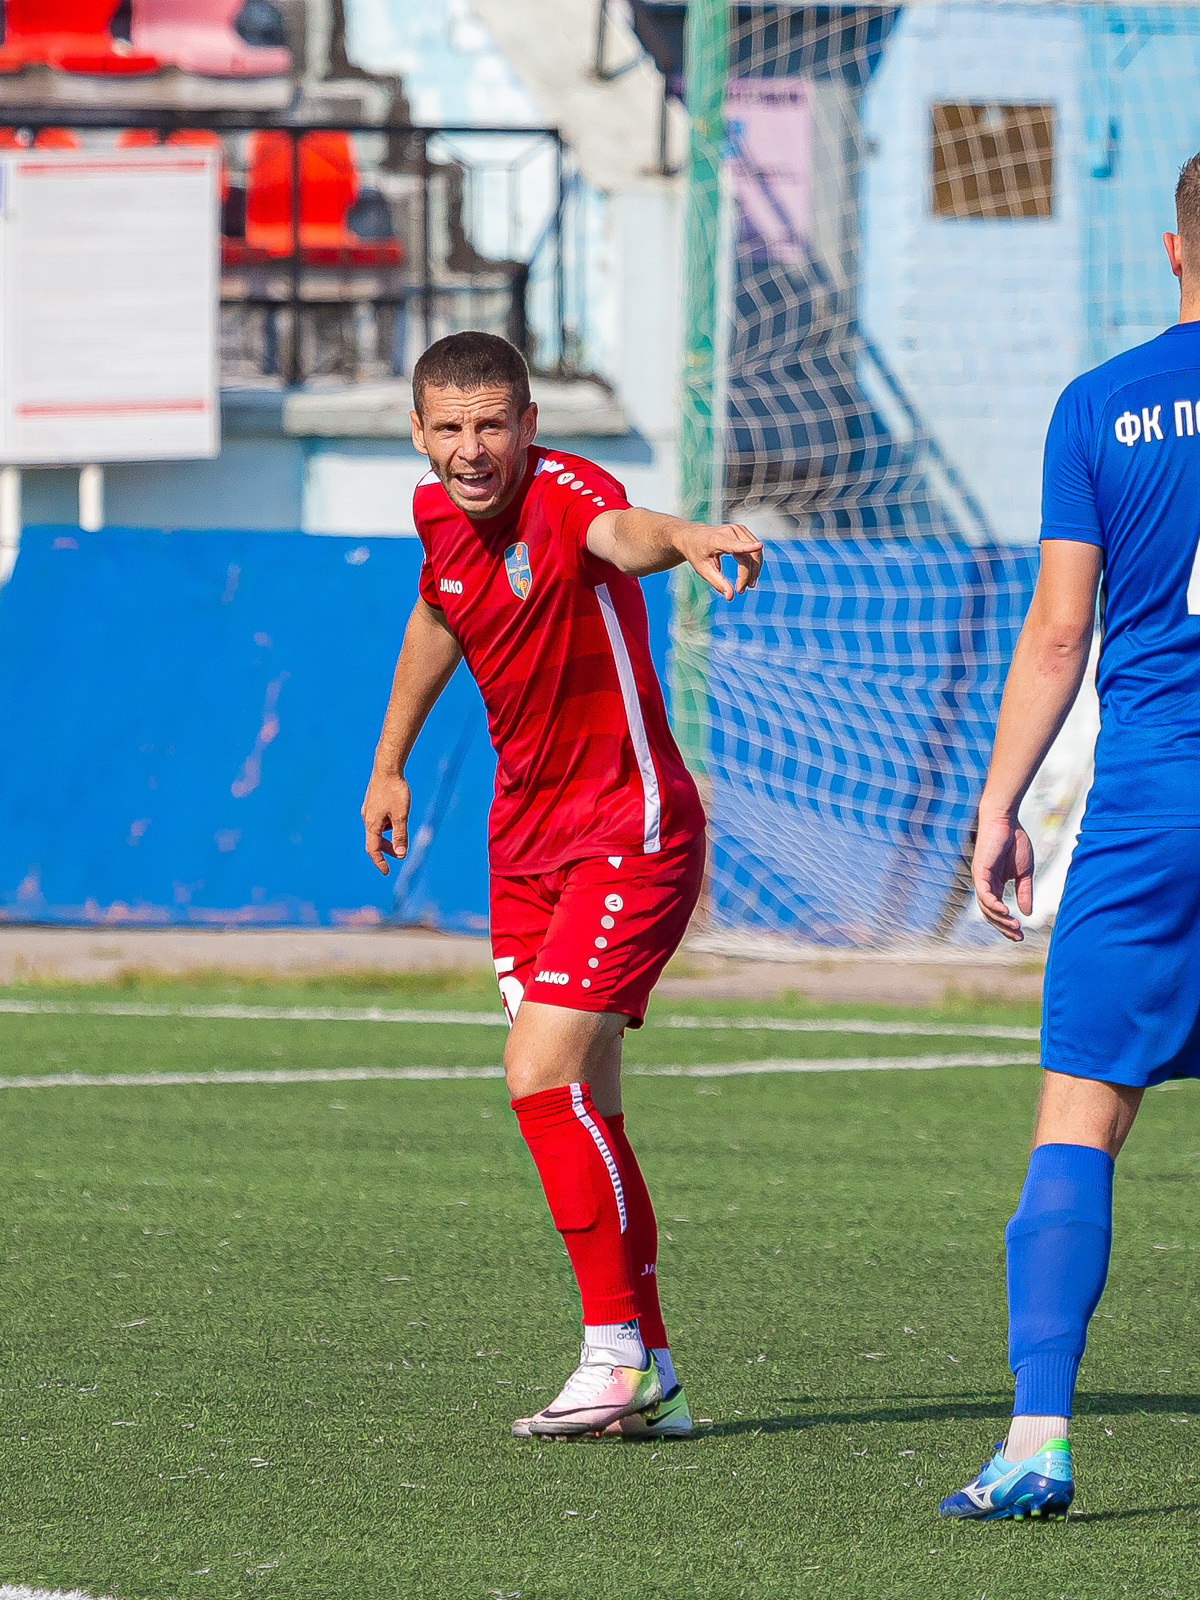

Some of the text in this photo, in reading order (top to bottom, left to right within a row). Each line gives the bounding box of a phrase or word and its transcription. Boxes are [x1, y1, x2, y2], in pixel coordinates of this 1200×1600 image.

[1114, 404, 1164, 447] ФК
[439, 578, 464, 595] JAKO
[534, 970, 570, 986] JAKO
[640, 1263, 656, 1276] JA
